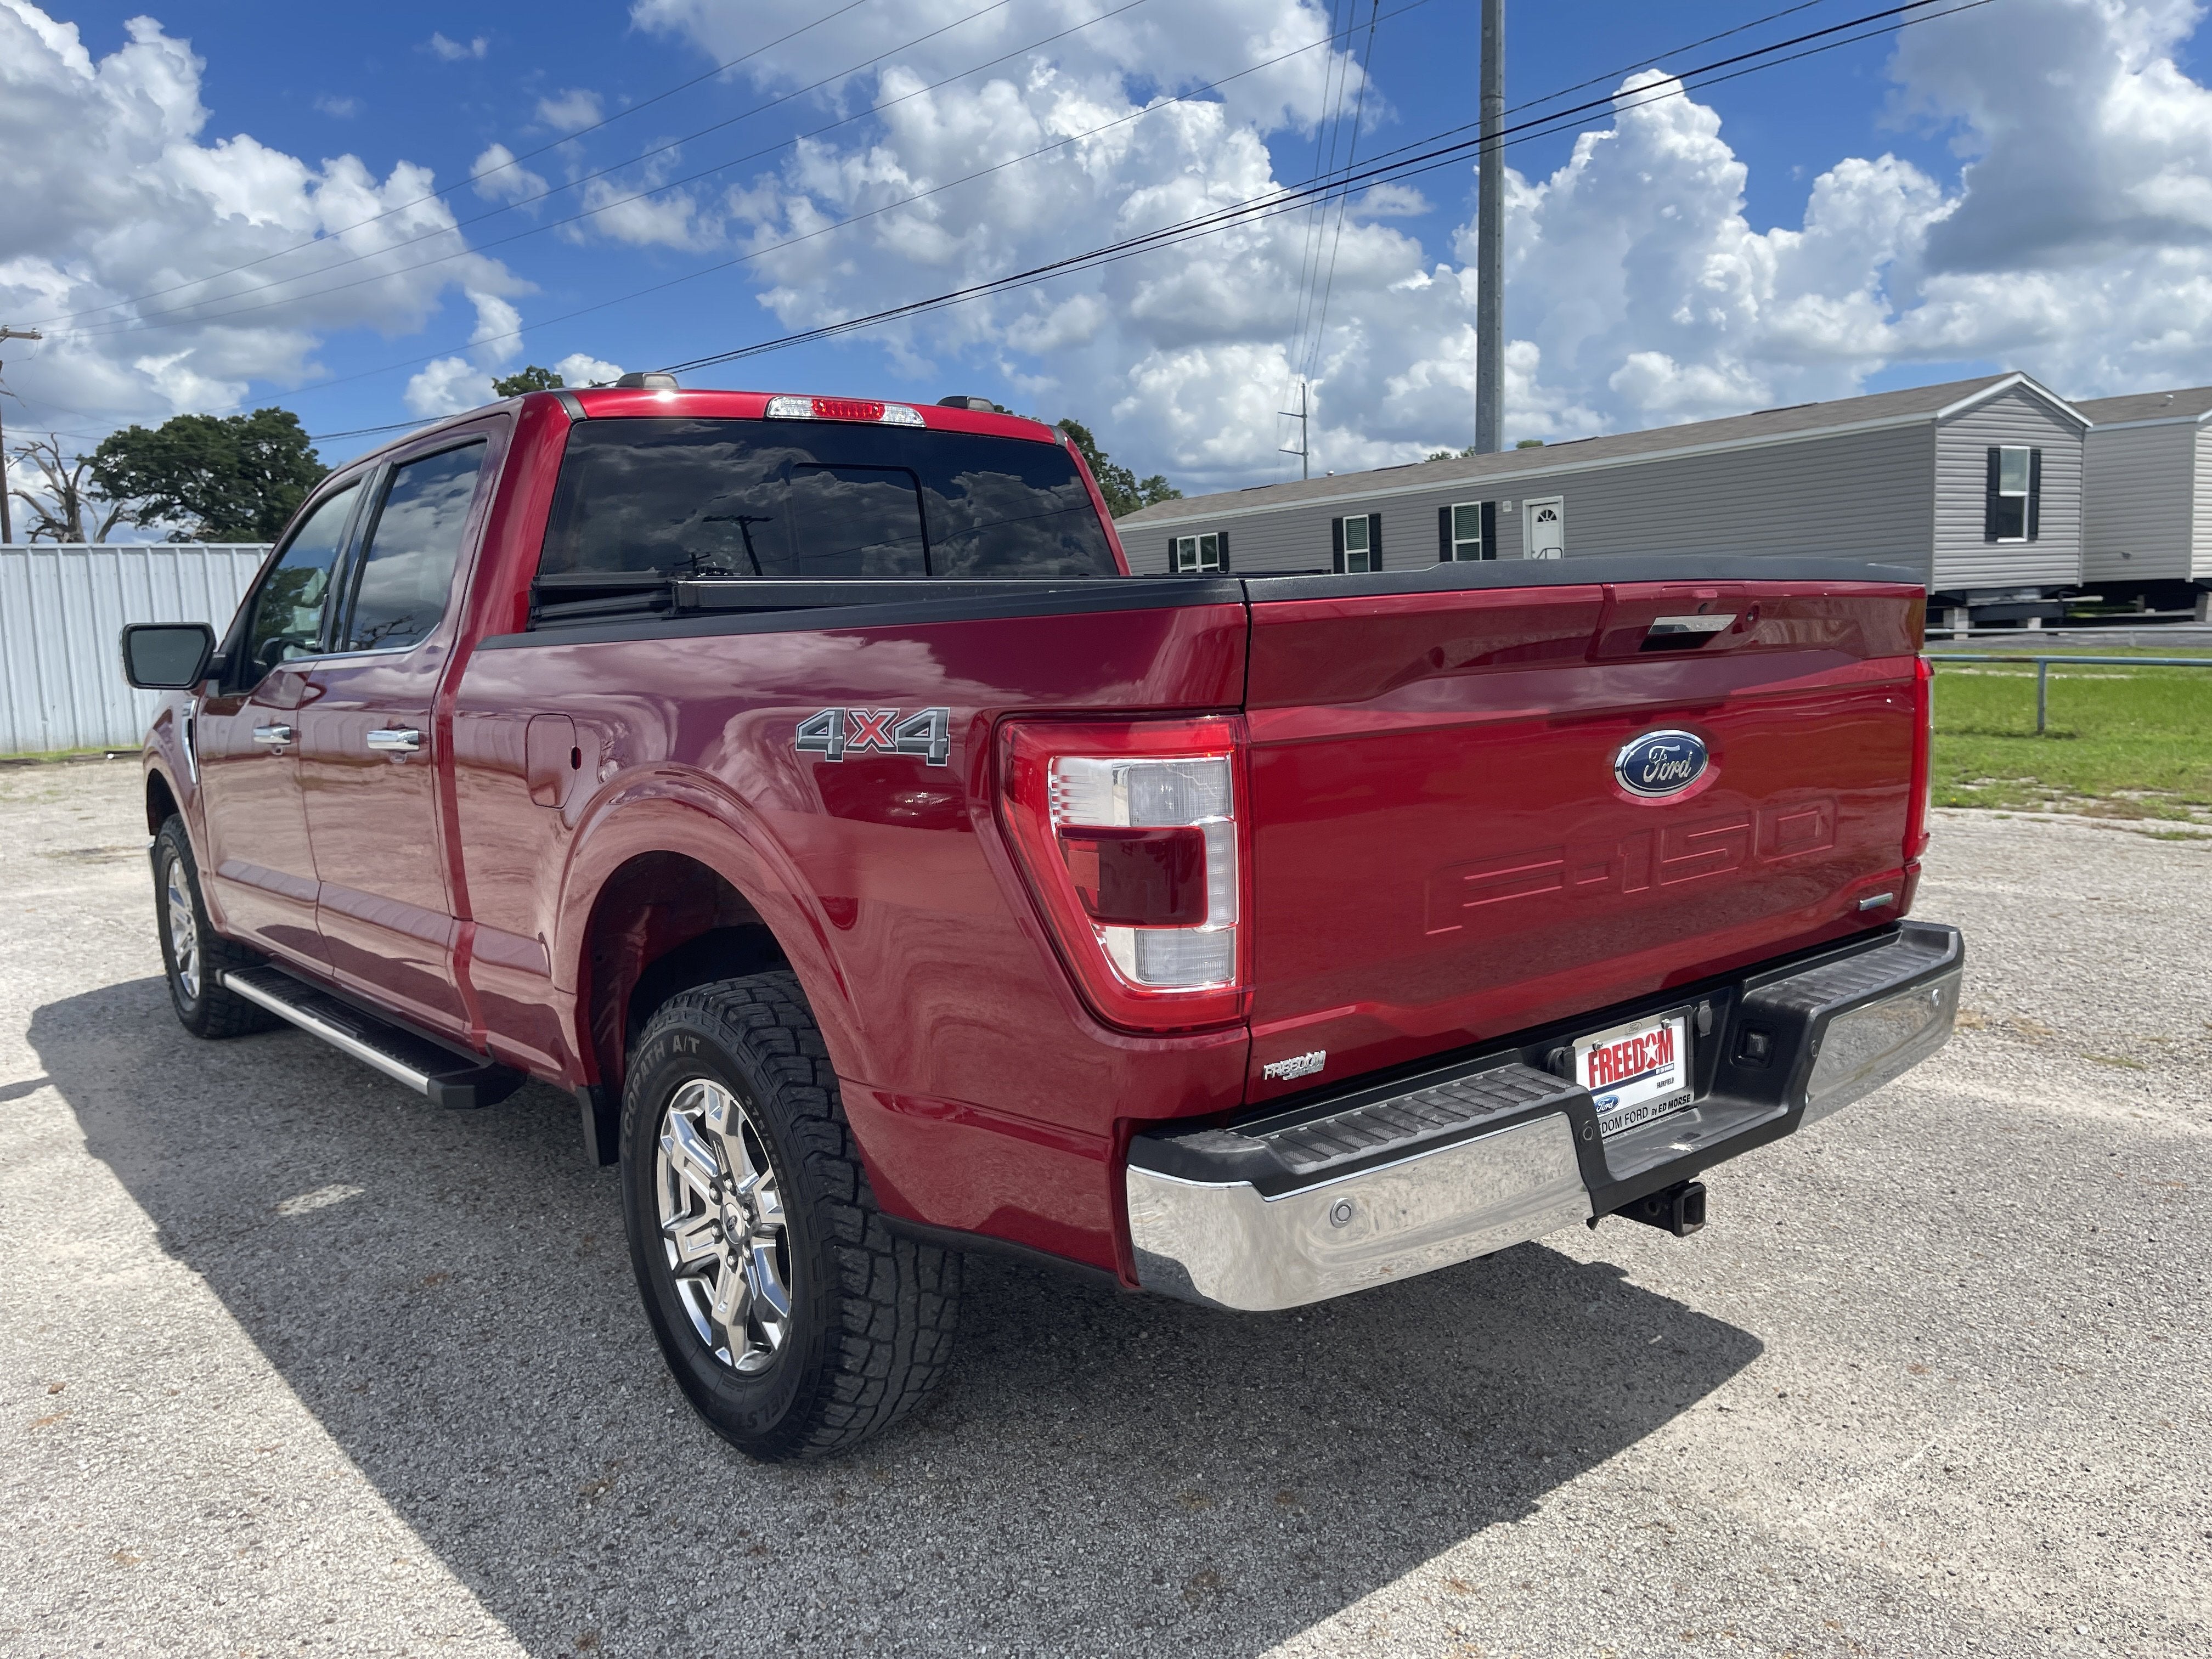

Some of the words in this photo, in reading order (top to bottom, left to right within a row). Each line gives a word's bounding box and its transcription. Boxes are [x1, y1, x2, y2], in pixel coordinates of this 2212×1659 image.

[1643, 744, 1693, 783] Ford
[1425, 797, 1837, 935] F-150
[673, 1035, 700, 1054] A/T
[1588, 1028, 1674, 1088] FREEDOM
[1263, 1050, 1326, 1080] FREEDOM
[1596, 1098, 1614, 1112] Ford
[1601, 1116, 1622, 1134] DOM
[1624, 1107, 1649, 1126] FORD
[1658, 1103, 1667, 1113] ED
[1668, 1093, 1691, 1109] MORSE
